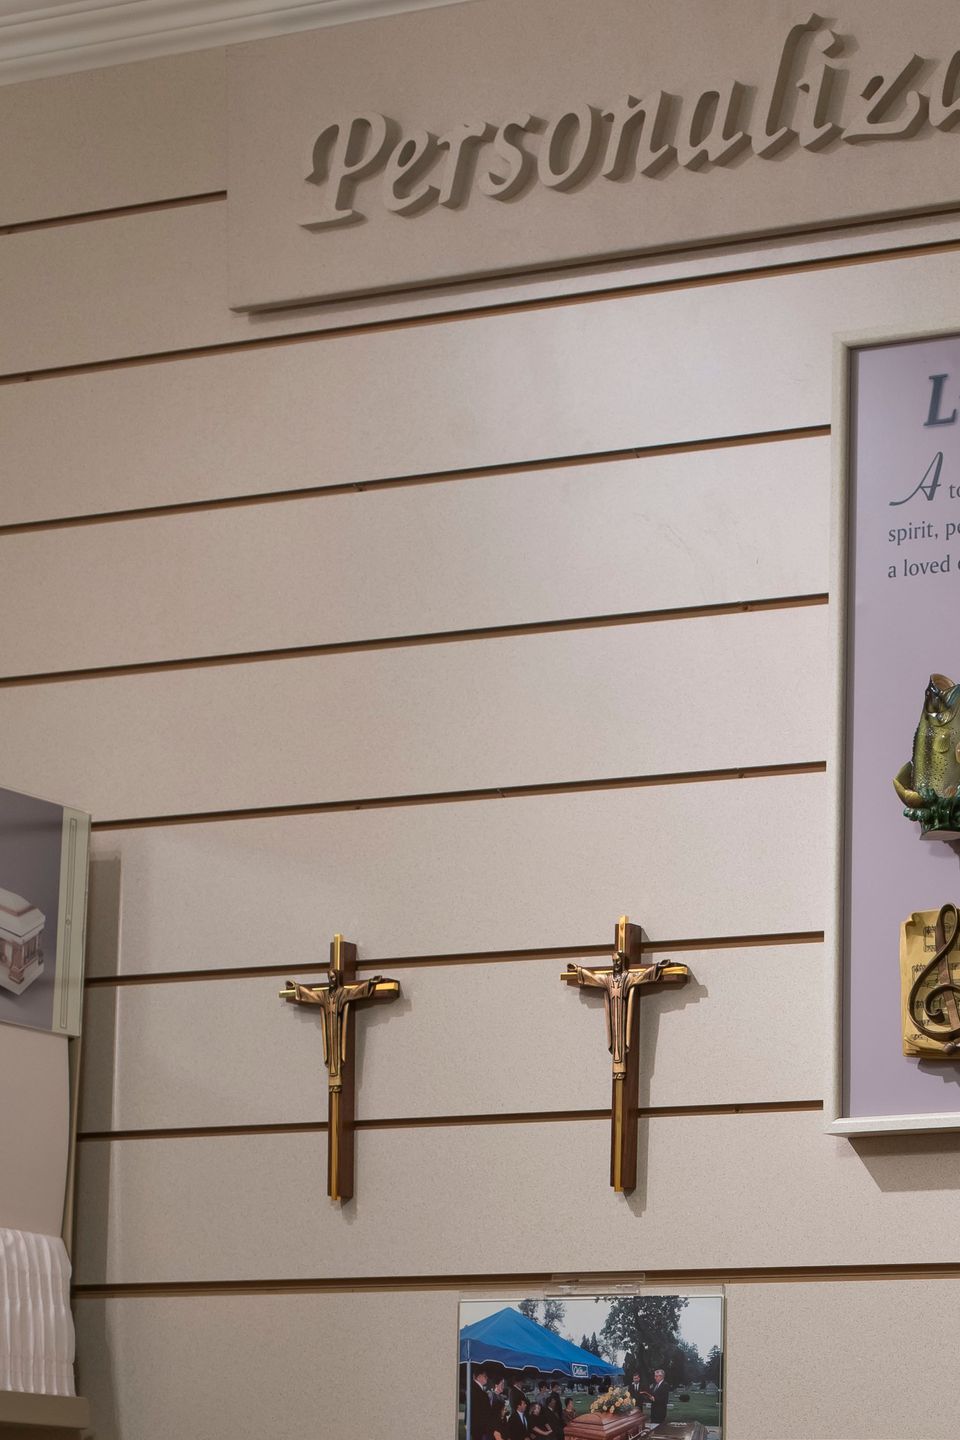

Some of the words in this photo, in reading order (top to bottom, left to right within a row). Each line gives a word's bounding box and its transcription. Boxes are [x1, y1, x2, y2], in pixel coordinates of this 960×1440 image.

[889, 451, 943, 506] A
[888, 520, 938, 545] spirit,
[888, 565, 897, 578] a
[904, 555, 950, 577] loved
